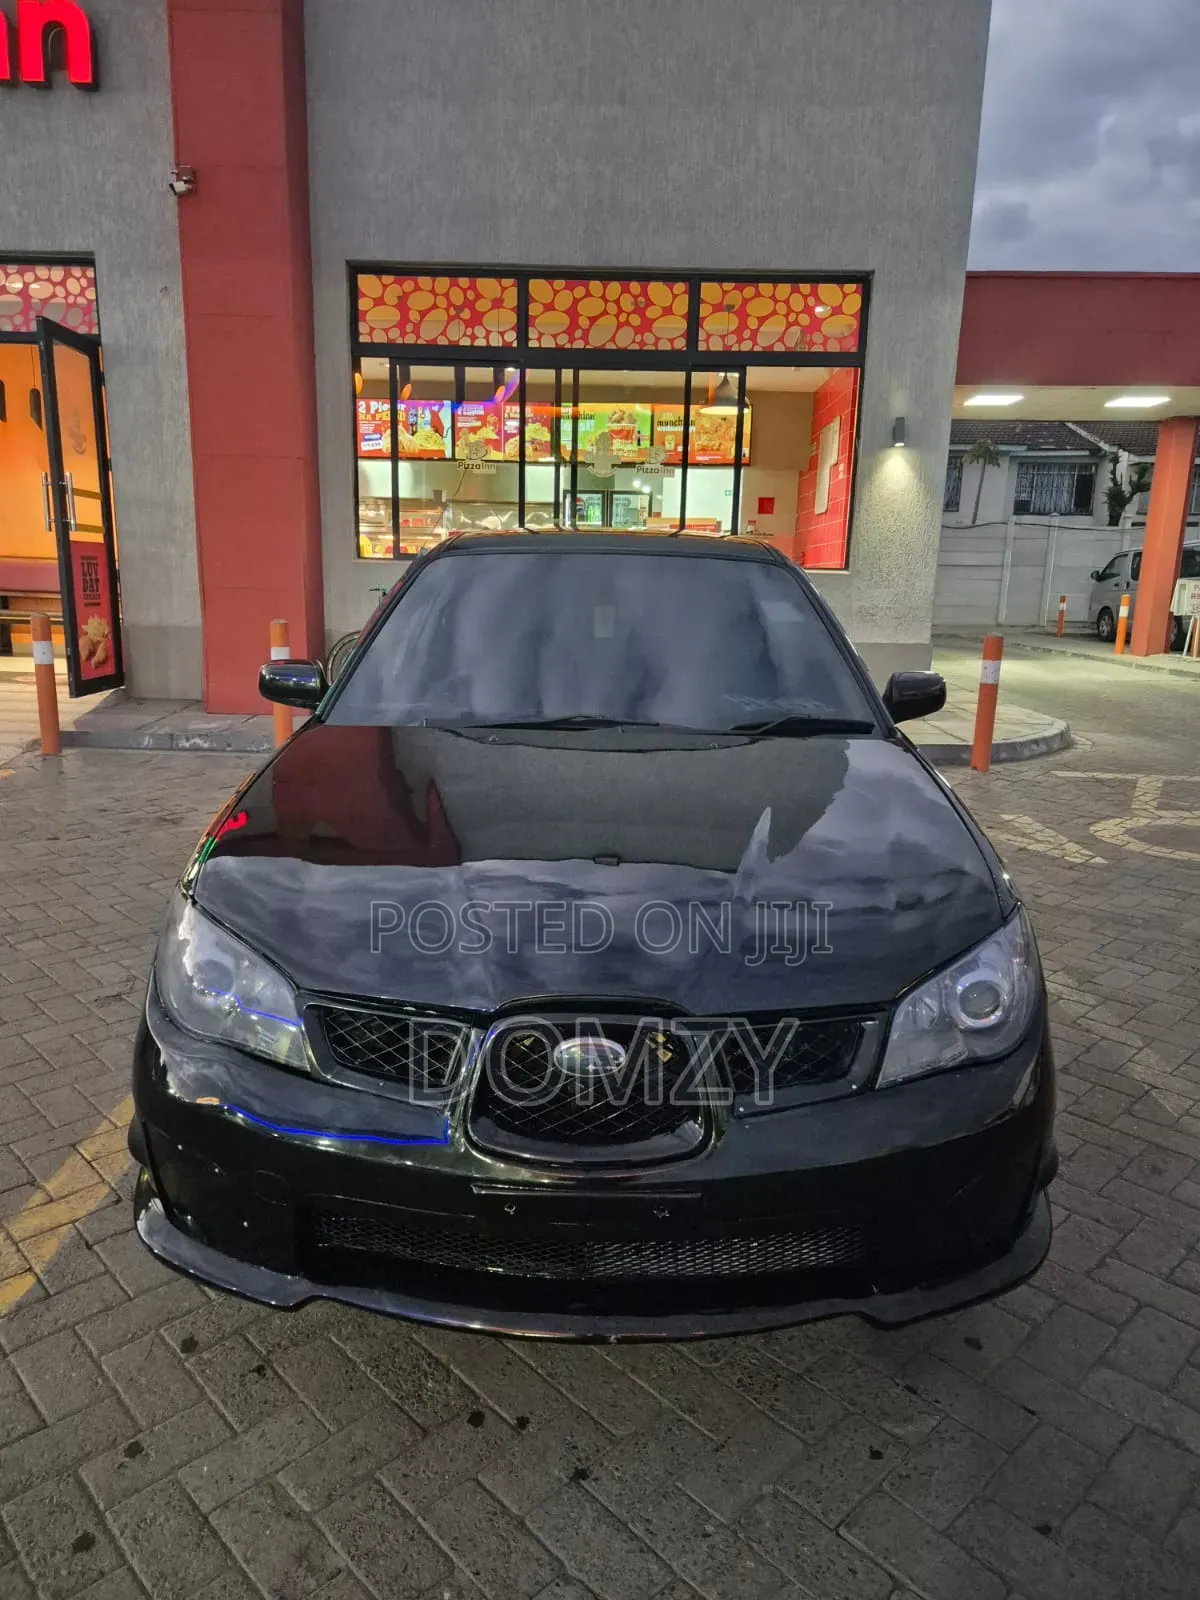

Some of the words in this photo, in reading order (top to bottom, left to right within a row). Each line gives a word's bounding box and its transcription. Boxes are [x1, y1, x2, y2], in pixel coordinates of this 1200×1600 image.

[0, 0, 93, 83] n
[81, 562, 98, 577] LUV
[82, 577, 100, 592] DAY
